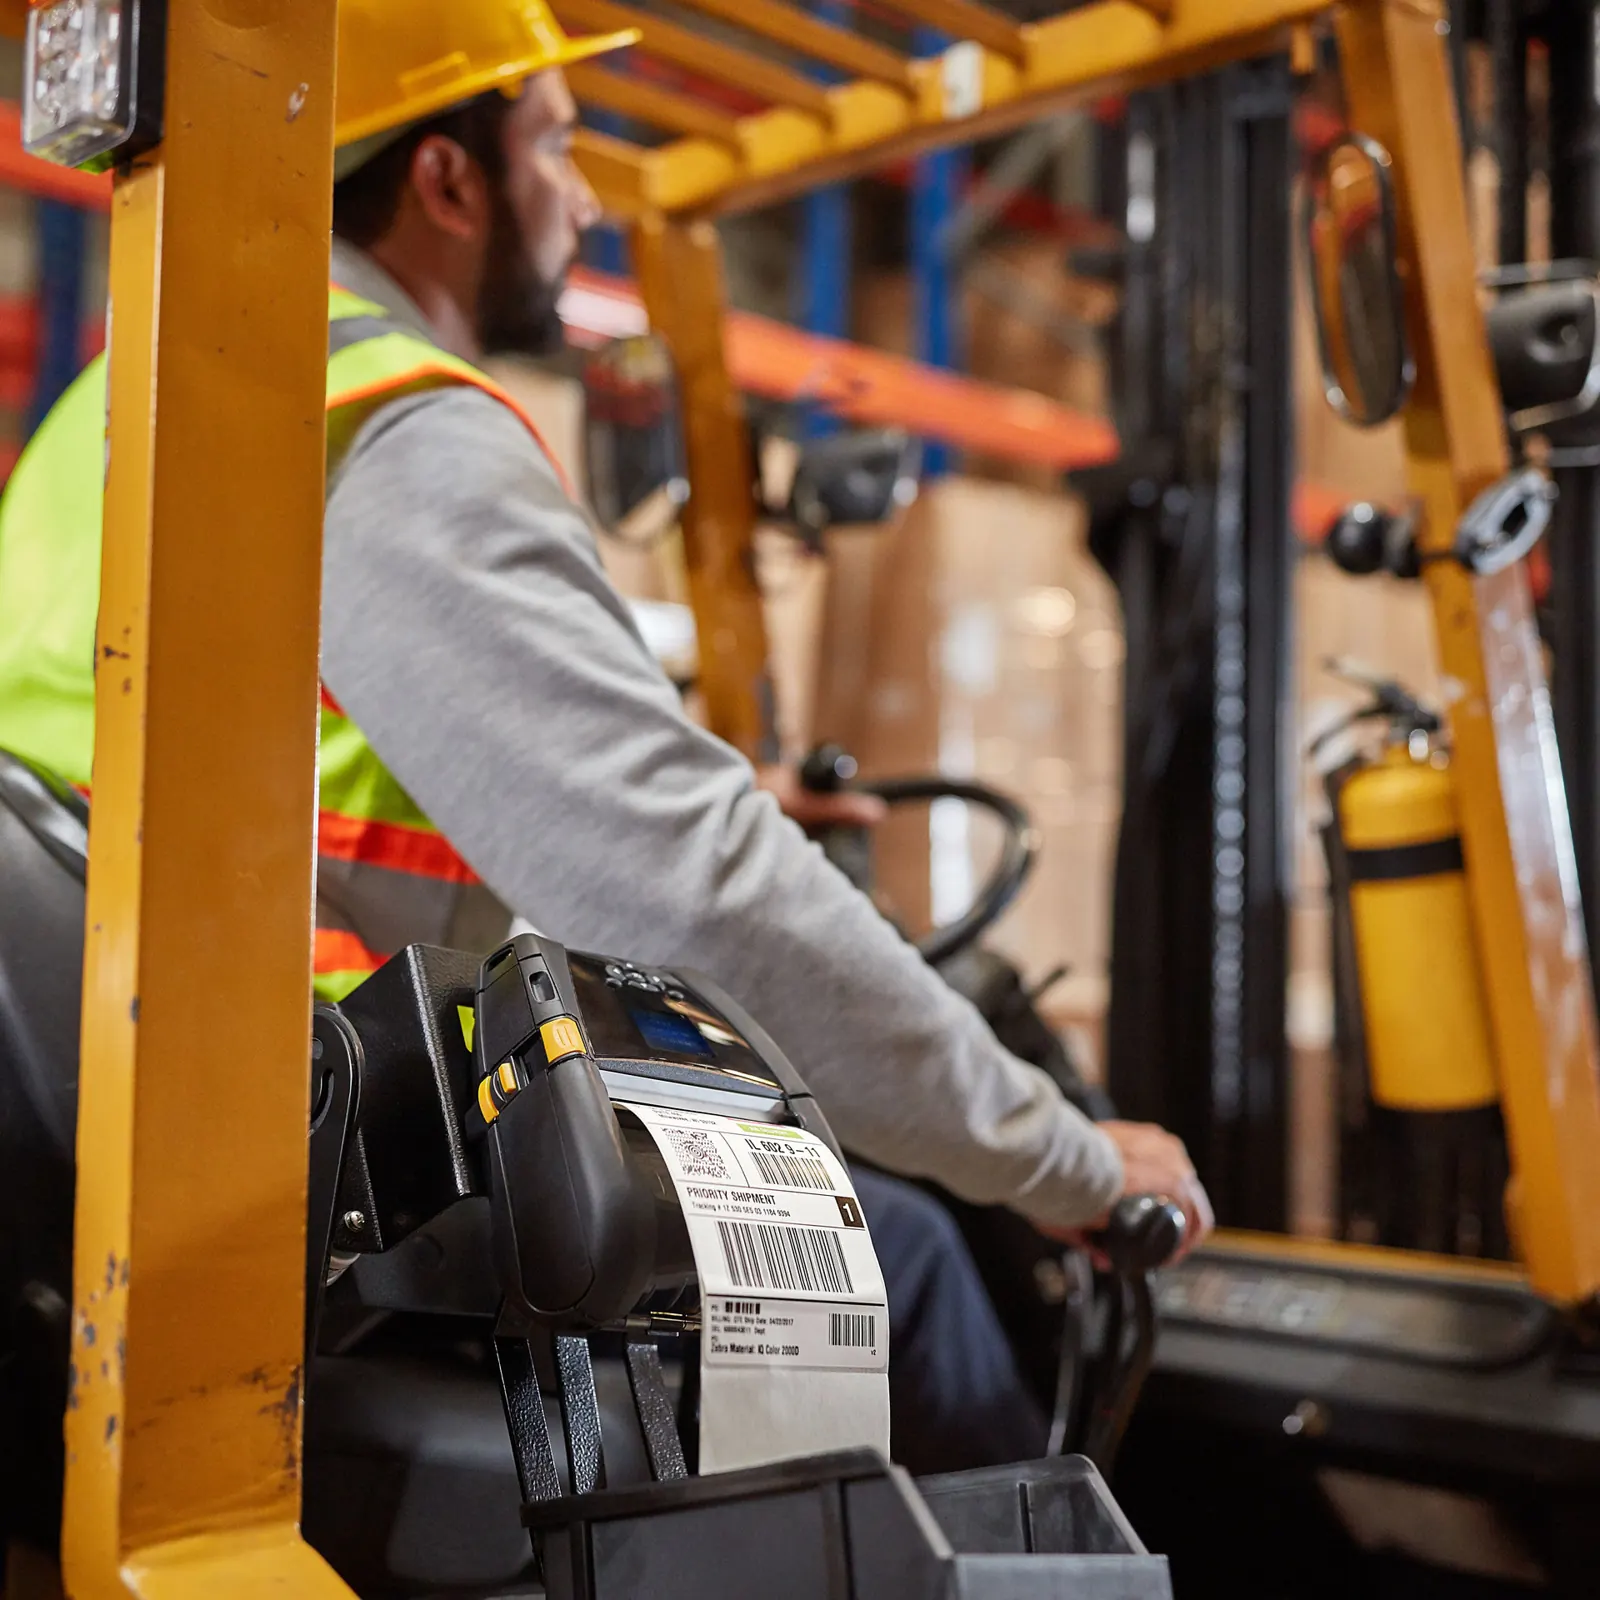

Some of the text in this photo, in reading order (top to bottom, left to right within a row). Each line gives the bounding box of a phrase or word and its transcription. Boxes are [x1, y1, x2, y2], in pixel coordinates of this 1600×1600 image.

[744, 1138, 761, 1150] IL
[760, 1140, 785, 1153] 602
[686, 1187, 776, 1205] PRIORITY SHIPMENT
[692, 1201, 716, 1212] Tracking
[842, 1203, 855, 1222] 1
[711, 1342, 728, 1353] Zebra
[758, 1344, 764, 1355] IQ
[765, 1344, 781, 1355] Color
[781, 1345, 799, 1356] 2000D
